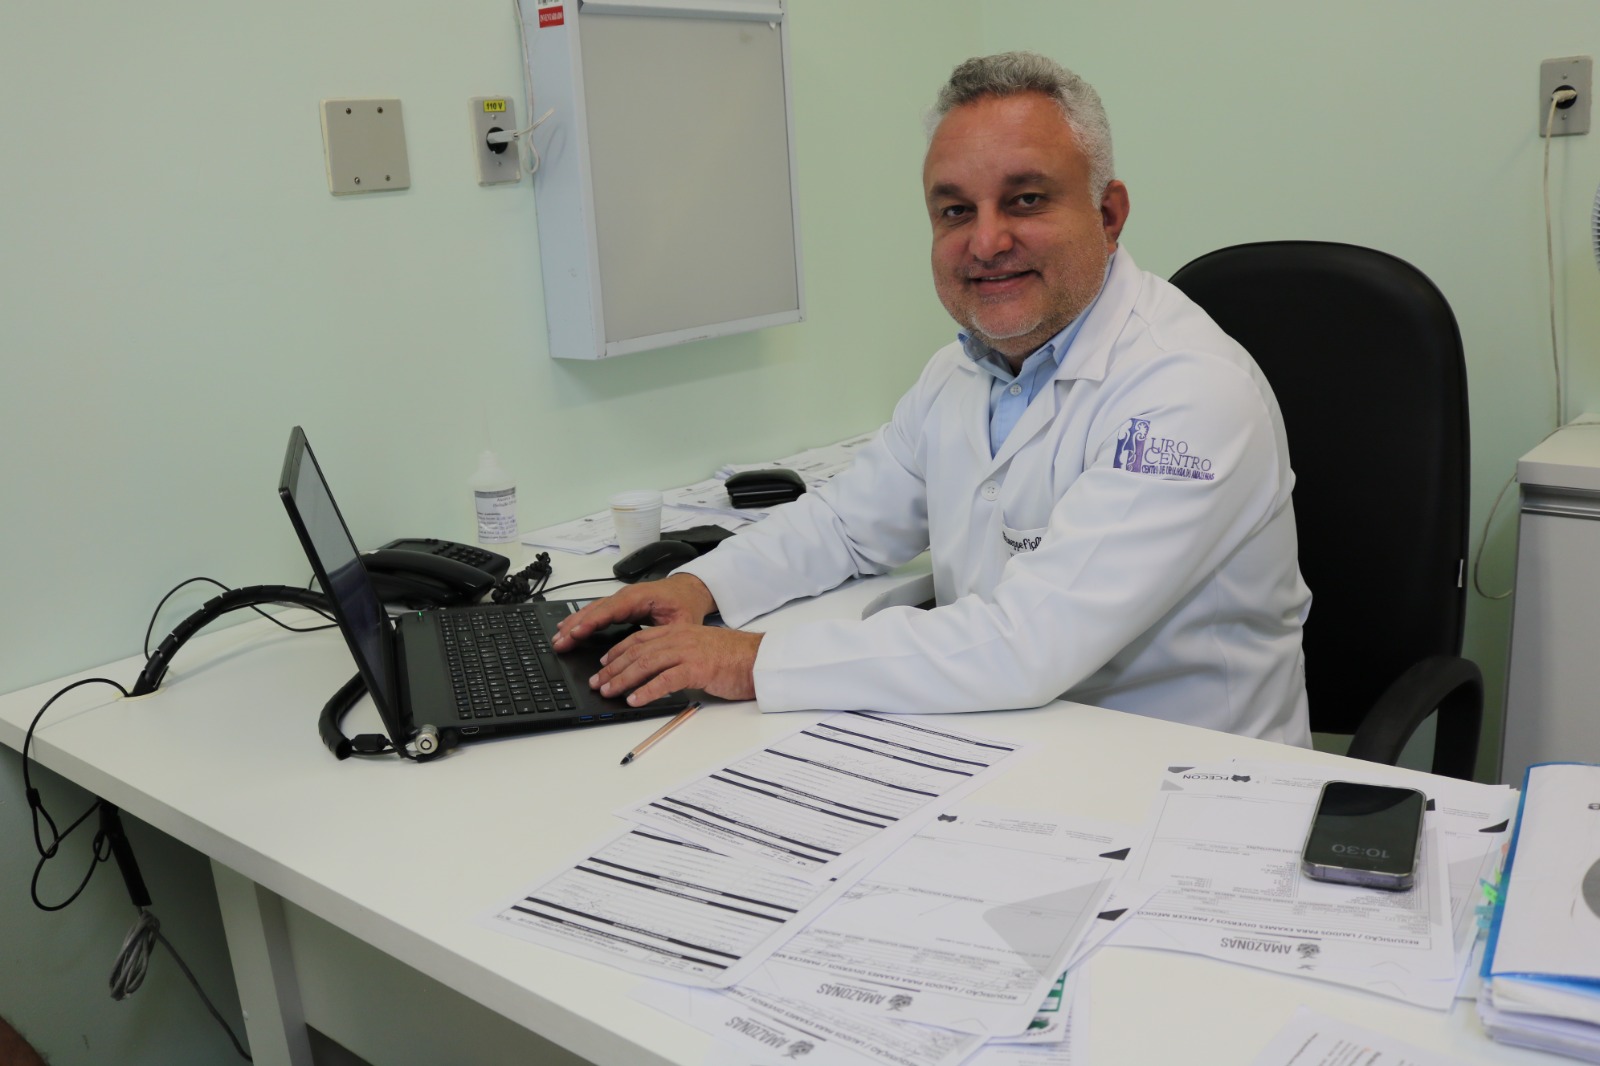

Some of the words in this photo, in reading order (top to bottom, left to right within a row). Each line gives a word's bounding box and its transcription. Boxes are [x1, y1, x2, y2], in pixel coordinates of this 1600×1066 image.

[486, 102, 497, 110] 110
[498, 102, 503, 110] V
[1151, 437, 1188, 454] URO
[1144, 446, 1212, 471] CENTRO
[1331, 844, 1390, 859] 10:30
[1220, 937, 1292, 954] AMAZONAS
[816, 983, 887, 1005] AMAZONAS
[725, 1016, 791, 1049] AMAZONAS
